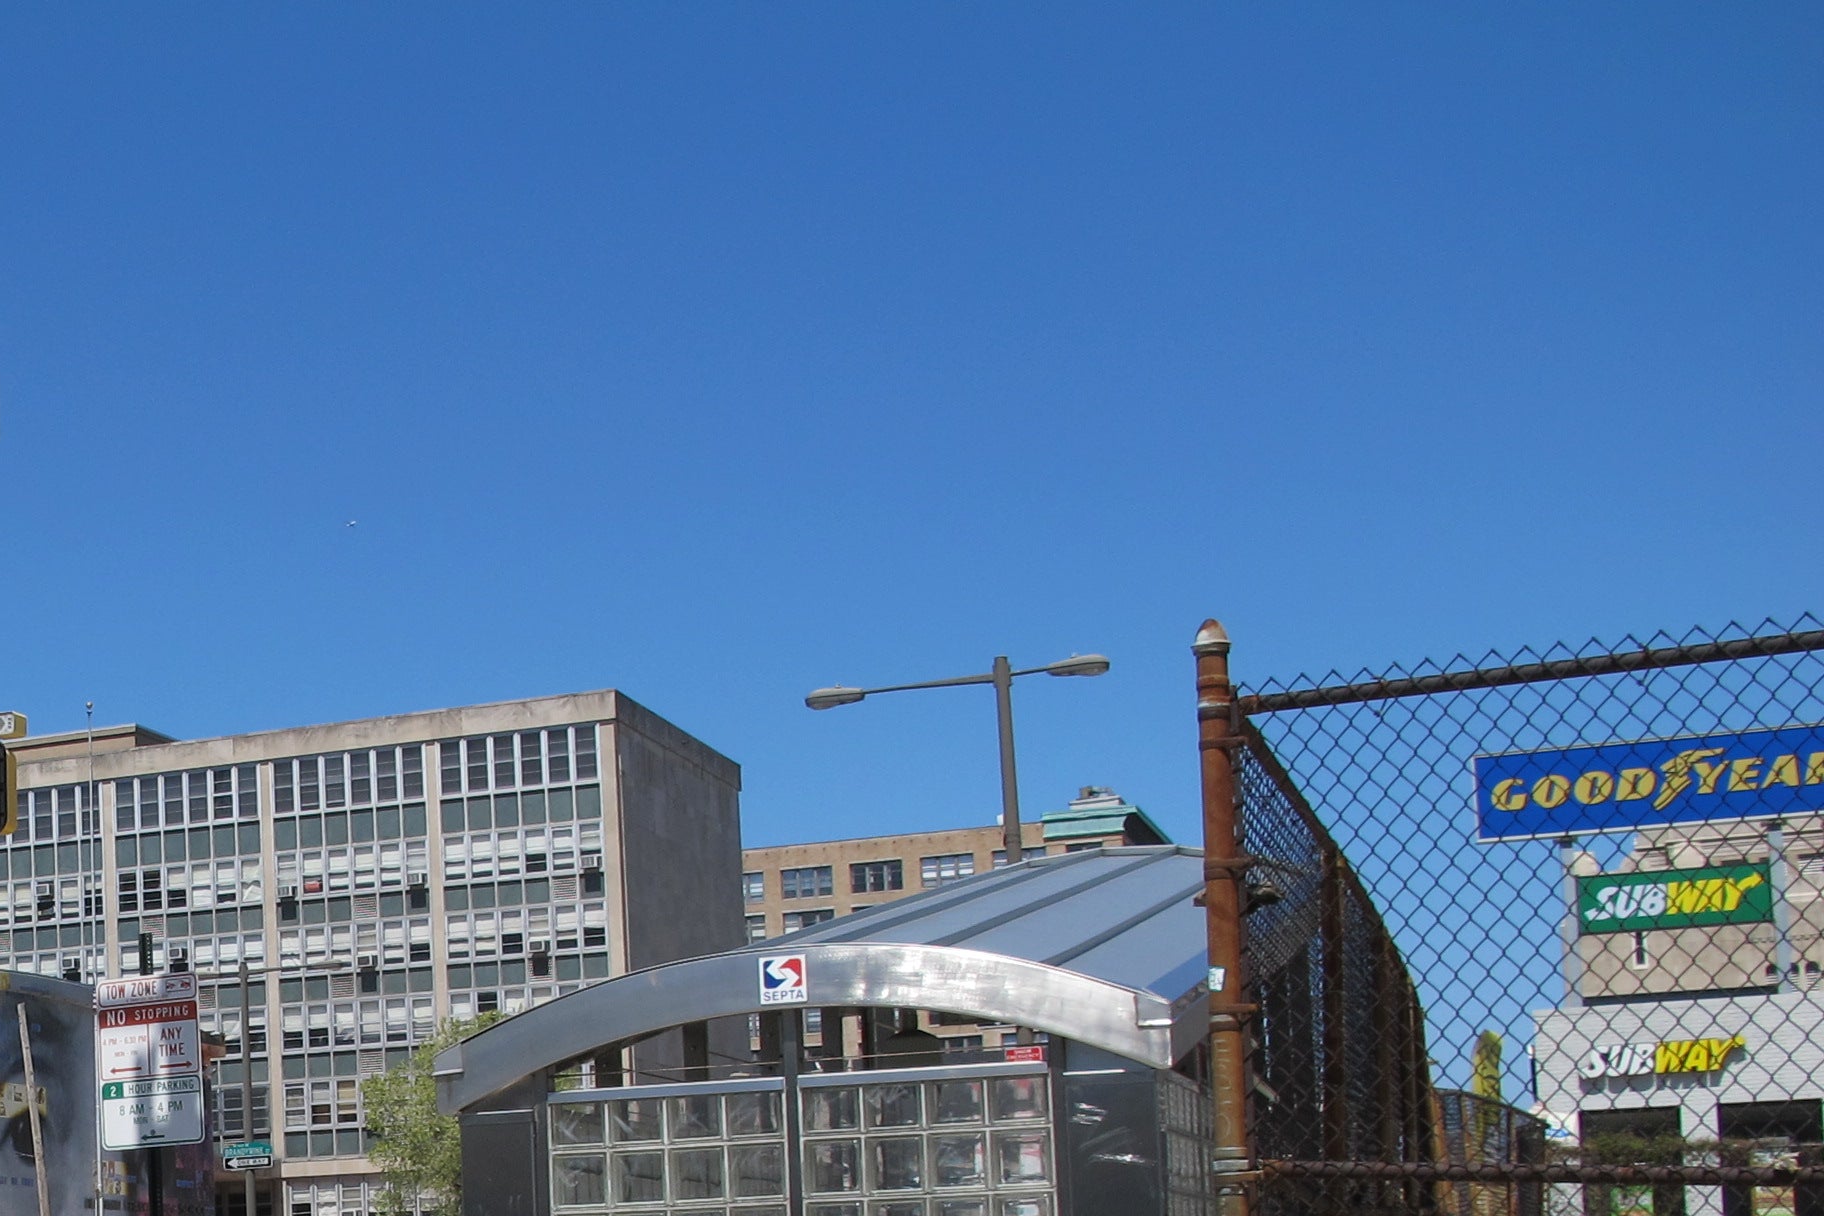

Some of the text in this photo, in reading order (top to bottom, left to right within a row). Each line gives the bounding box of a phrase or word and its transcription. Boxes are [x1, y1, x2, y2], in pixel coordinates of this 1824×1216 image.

[1584, 873, 1764, 922] SUBWAY
[106, 981, 158, 1000] TOW ZONE
[763, 989, 804, 1002] SEPTA
[107, 1005, 189, 1026] NO STOPPING
[160, 1026, 183, 1040] ANY
[158, 1042, 185, 1057] TIME
[1580, 1035, 1748, 1081] SUBWAY
[109, 1079, 195, 1097] 2 HOUR PARKING
[119, 1105, 125, 1116] 8
[129, 1104, 145, 1115] AM
[157, 1102, 164, 1112] 4
[168, 1101, 183, 1112] PM
